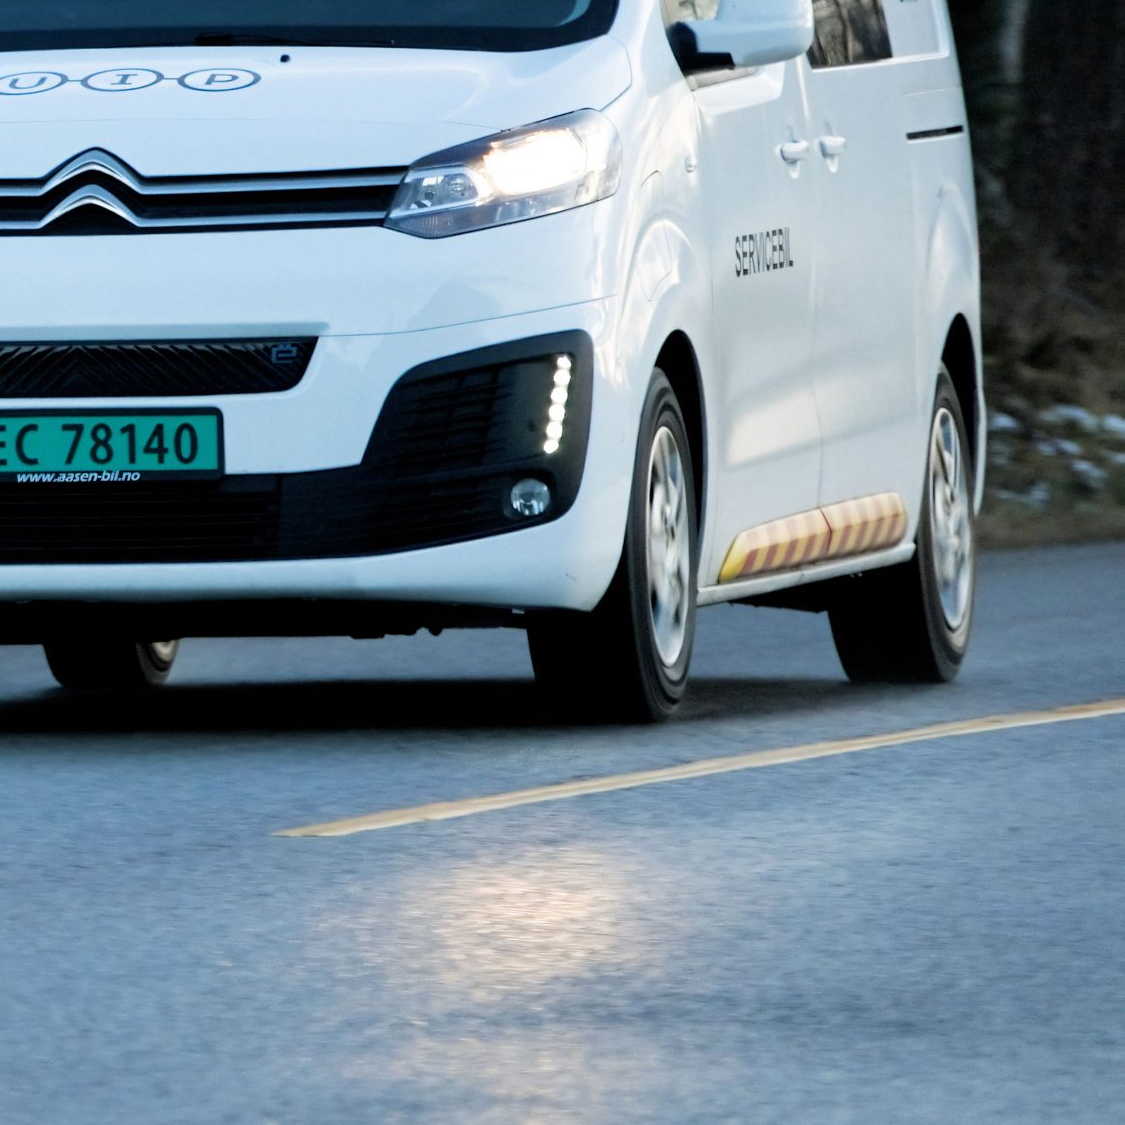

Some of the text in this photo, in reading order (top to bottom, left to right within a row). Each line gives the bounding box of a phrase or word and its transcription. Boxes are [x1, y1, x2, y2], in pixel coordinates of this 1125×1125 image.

[734, 227, 794, 277] SERVICEBIL
[61, 422, 198, 465] 78140
[16, 470, 141, 483] www.aasen-bil.no
